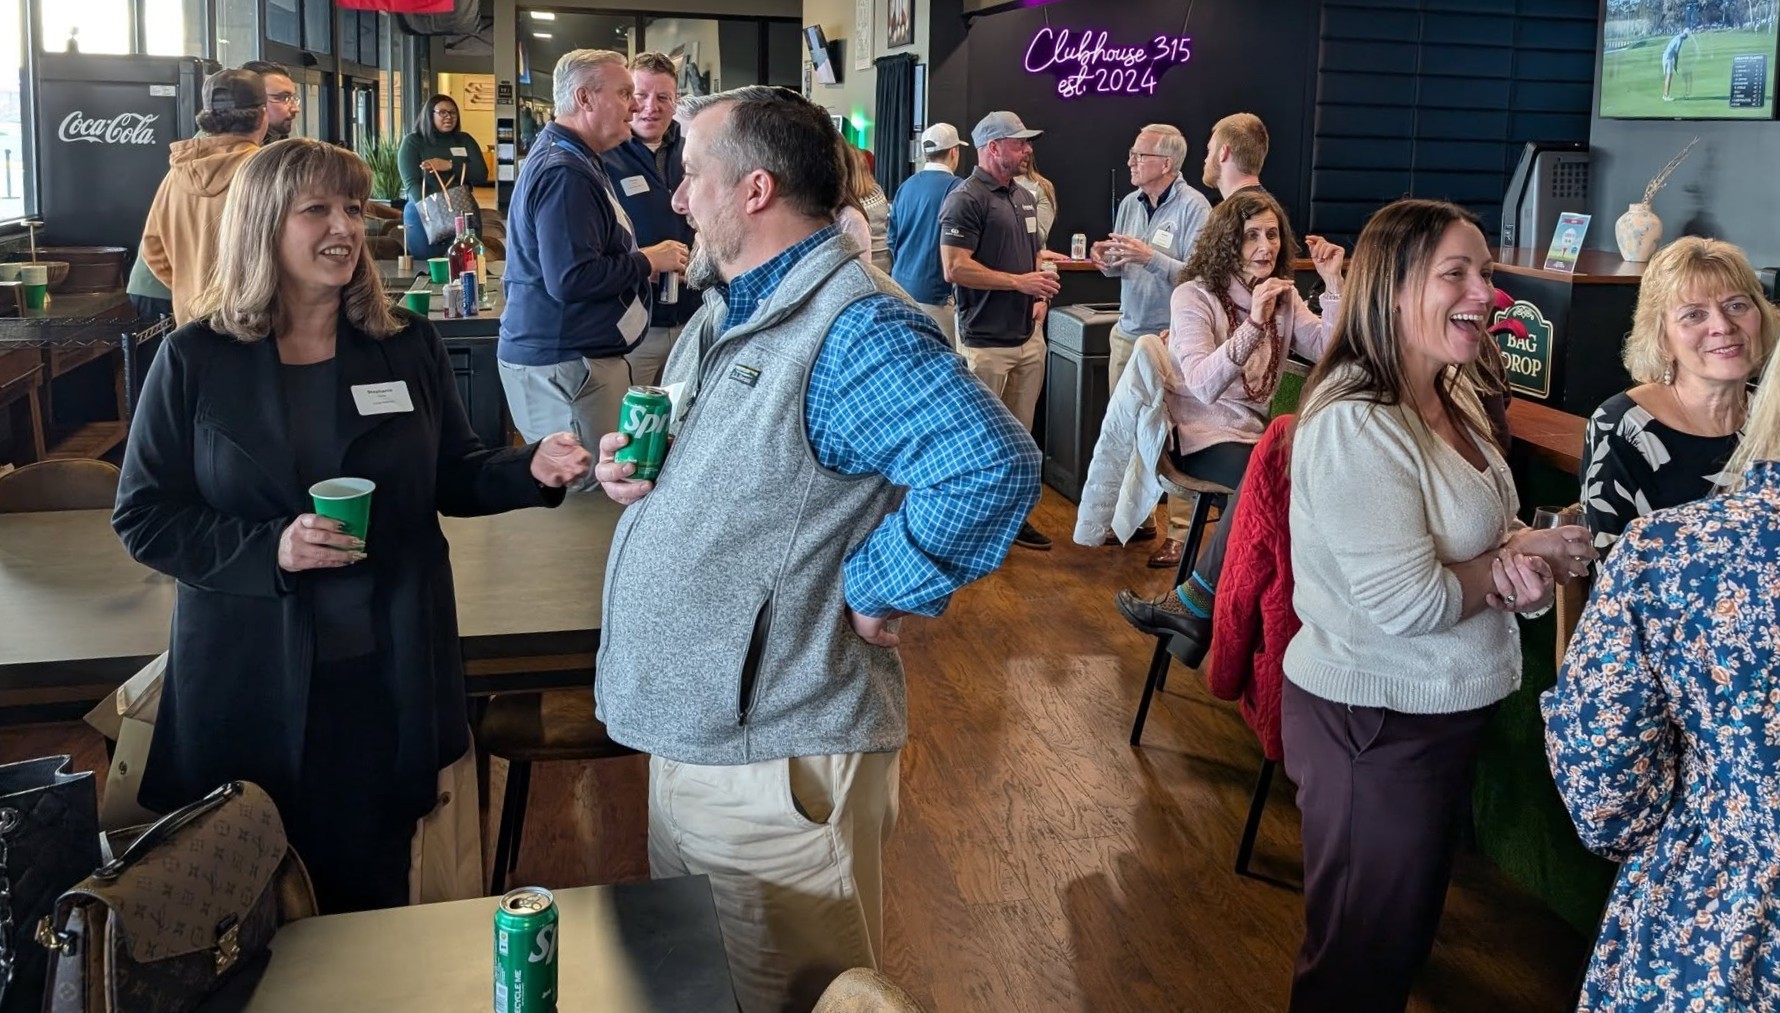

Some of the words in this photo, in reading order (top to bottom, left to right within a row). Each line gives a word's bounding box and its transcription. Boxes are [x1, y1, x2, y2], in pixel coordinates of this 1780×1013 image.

[1025, 27, 1147, 72] Clubhouse
[1154, 35, 1191, 63] 315
[1058, 65, 1094, 97] est.
[1096, 68, 1157, 94] 2024
[1507, 333, 1538, 353] BAG
[1501, 351, 1542, 377] DROP
[514, 969, 522, 982] ME
